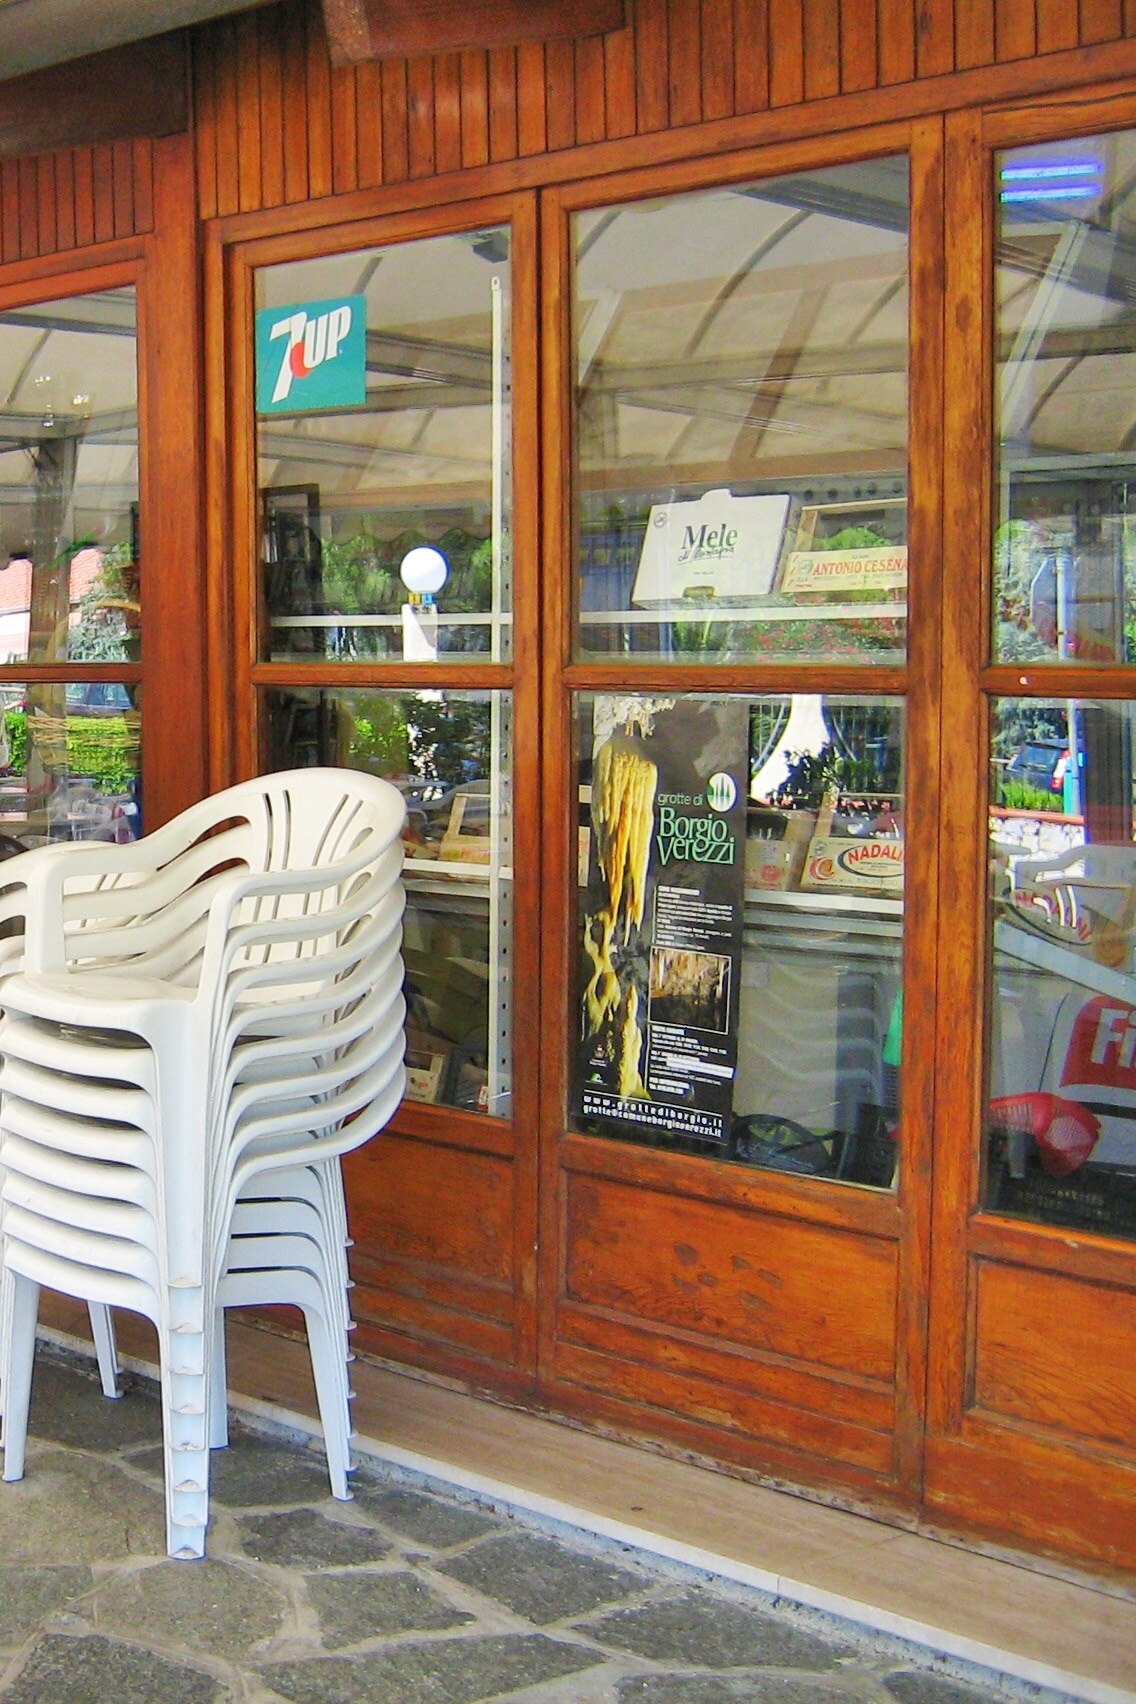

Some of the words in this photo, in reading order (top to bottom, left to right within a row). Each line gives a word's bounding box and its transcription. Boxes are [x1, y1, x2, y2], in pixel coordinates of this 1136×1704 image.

[681, 522, 739, 549] Mele
[812, 559, 862, 576] ANTONIO
[657, 793, 692, 806] grotte
[693, 793, 704, 806] di
[659, 806, 728, 843] Borgio
[656, 836, 735, 866] Verezzi
